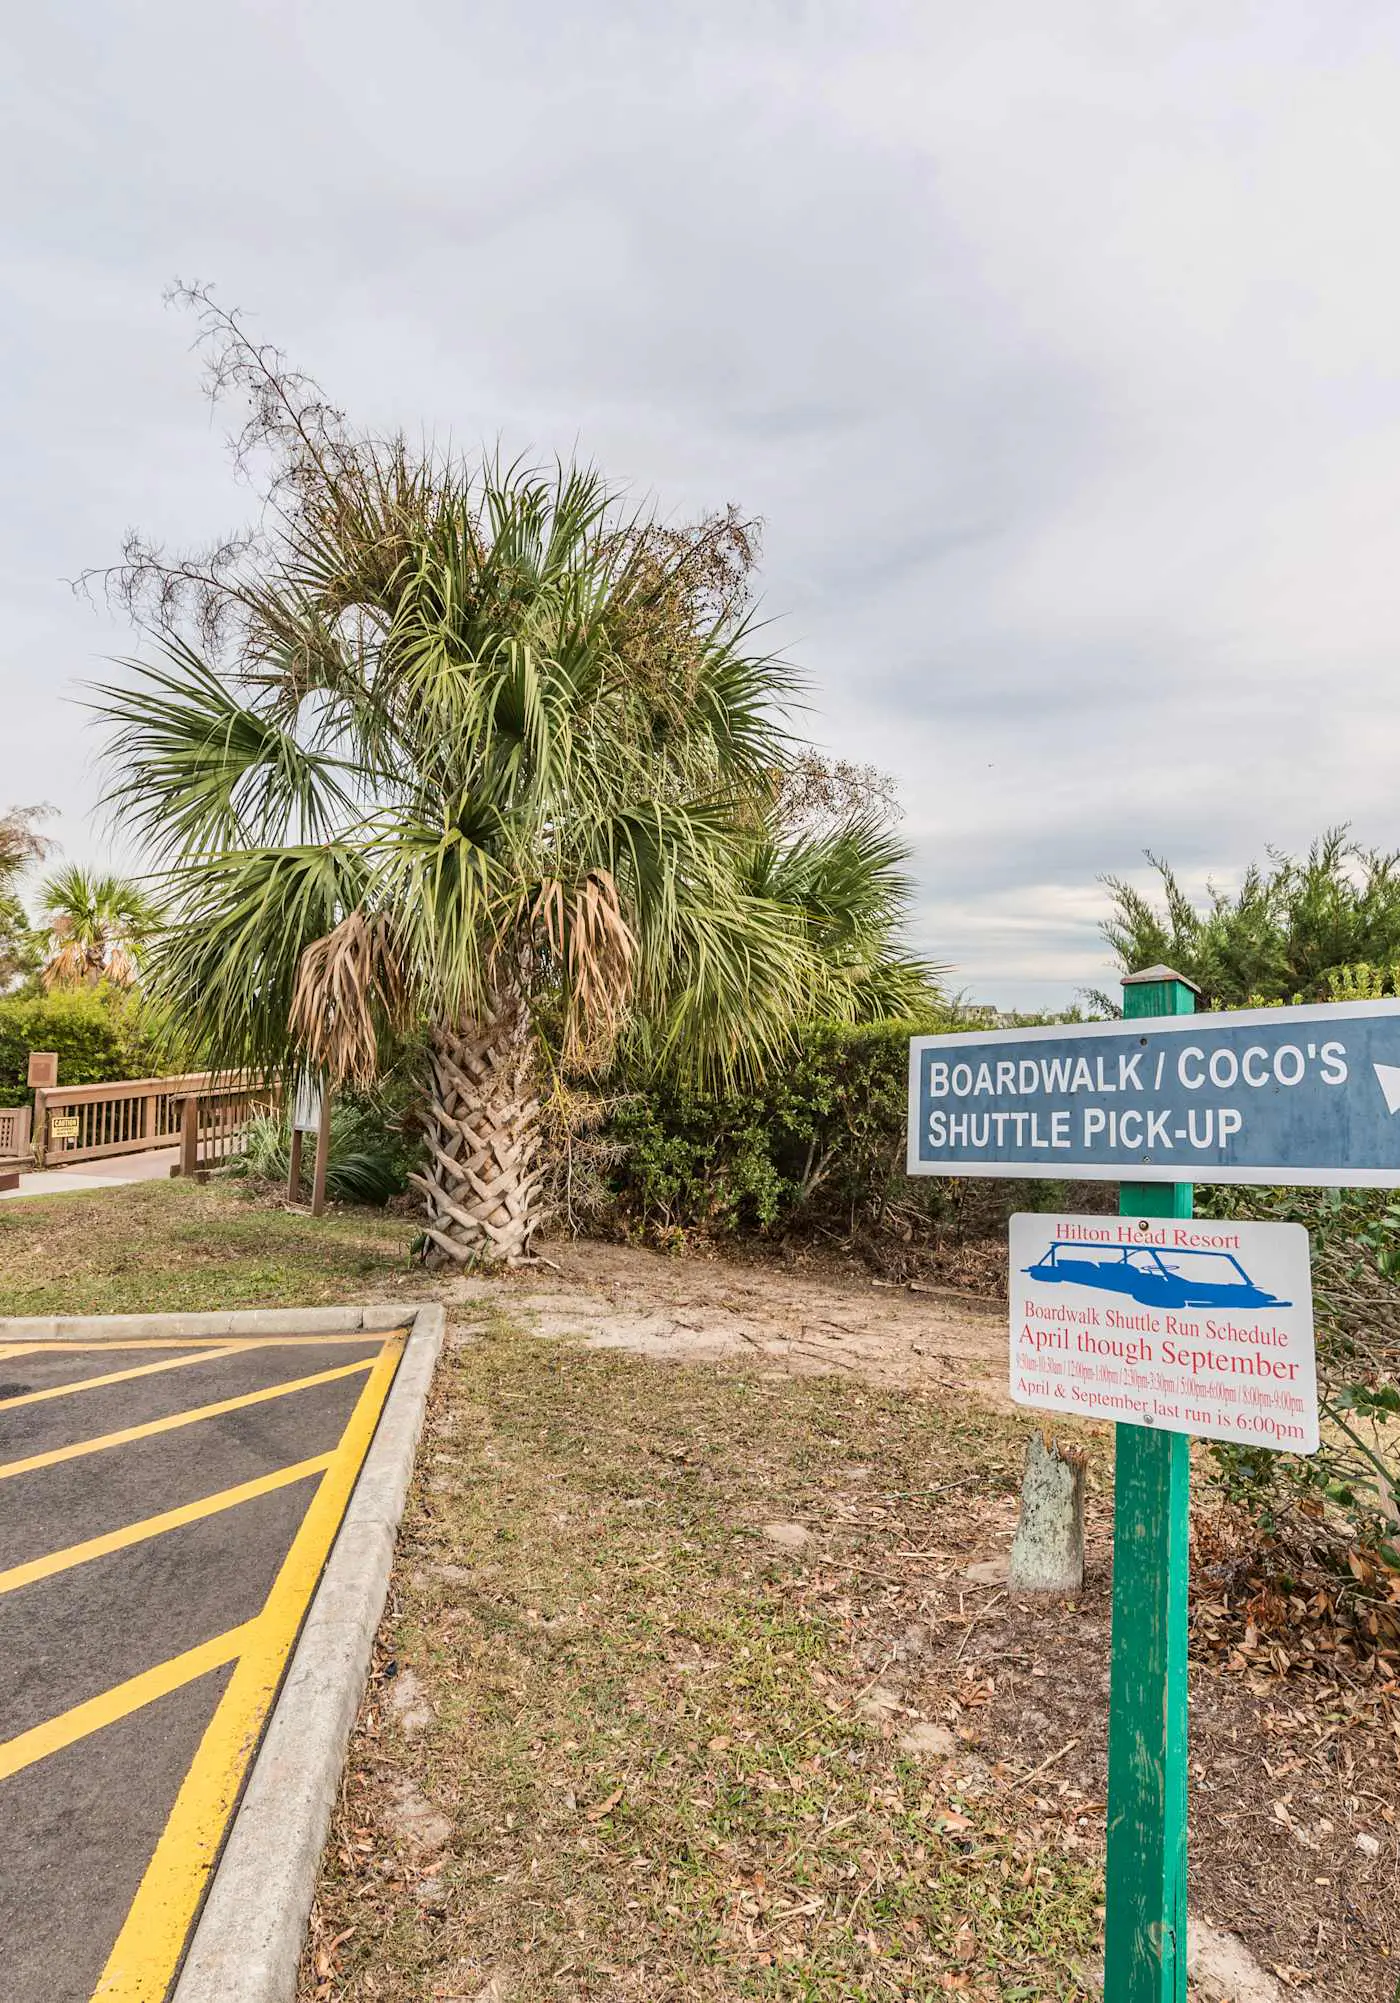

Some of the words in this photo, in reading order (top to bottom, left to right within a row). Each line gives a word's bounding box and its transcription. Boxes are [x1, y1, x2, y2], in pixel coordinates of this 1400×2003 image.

[929, 1053, 1145, 1098] BOARDWALK
[1154, 1052, 1166, 1091] /
[1177, 1041, 1349, 1090] COCO'S
[928, 1110, 1072, 1148] SHUTTLE
[1082, 1107, 1243, 1149] PICK-UP
[1056, 1223, 1111, 1241] Hilton
[1117, 1226, 1165, 1245] Head
[1173, 1229, 1241, 1249] Resort
[1025, 1300, 1100, 1326] Boardwalk
[1105, 1309, 1160, 1333] Shuttle
[1166, 1315, 1200, 1338] Run
[1206, 1320, 1289, 1347] Schedule
[1019, 1323, 1069, 1352] April
[1077, 1330, 1152, 1365] though
[1161, 1341, 1299, 1380] September
[1018, 1377, 1049, 1396] April
[1054, 1383, 1066, 1398] &
[1071, 1385, 1149, 1412] September
[1153, 1399, 1180, 1418] last
[1185, 1408, 1211, 1425] run
[1218, 1409, 1231, 1427] is
[1236, 1413, 1304, 1440] 6:00pm
